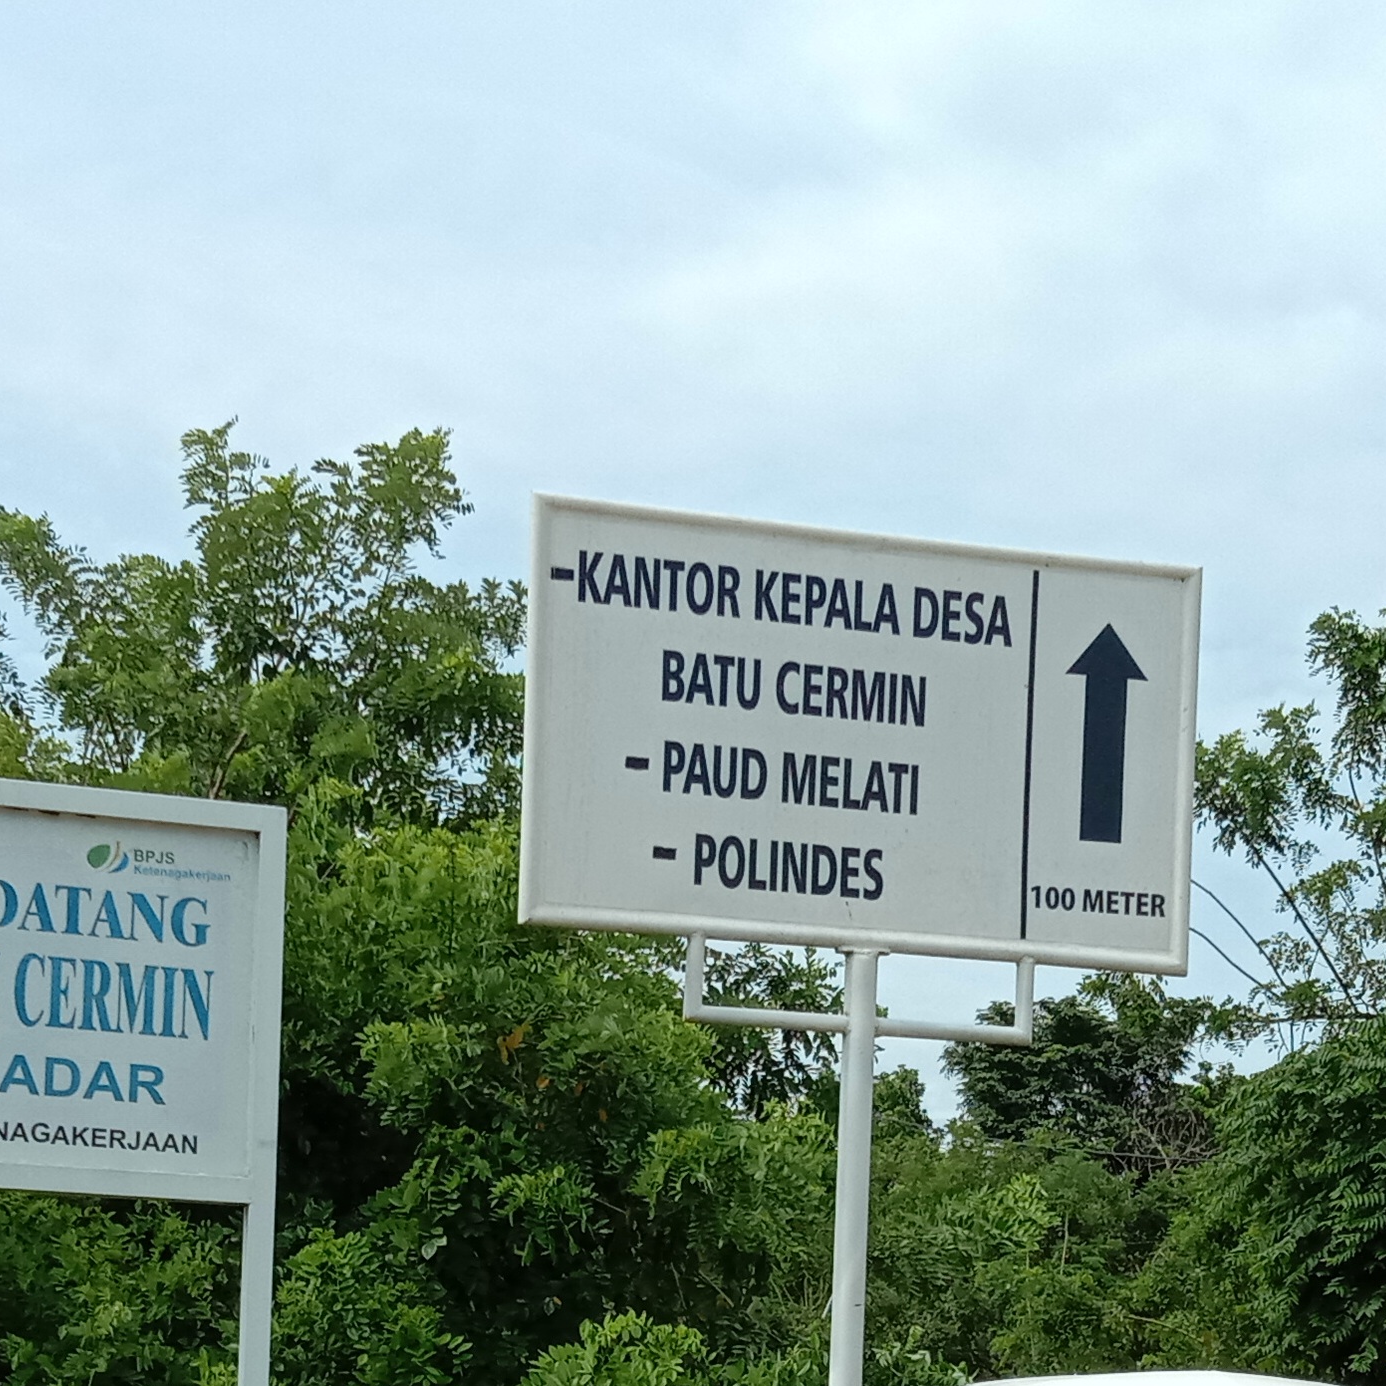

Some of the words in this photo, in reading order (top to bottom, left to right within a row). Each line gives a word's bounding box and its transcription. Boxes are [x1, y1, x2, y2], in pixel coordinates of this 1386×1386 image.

[755, 568, 900, 636] KEPALA
[913, 586, 1012, 647] DESA
[661, 649, 761, 710] BATU
[776, 660, 927, 727] CERMIN
[662, 740, 767, 801] PAUD
[781, 751, 919, 816] MELATI
[133, 865, 231, 882] Ketenagakerjaan
[134, 849, 175, 865] BPJS
[694, 833, 884, 902] POLINDES
[1030, 885, 1075, 913] 100
[1081, 889, 1166, 918] METER
[15, 952, 214, 1042] CERMIN
